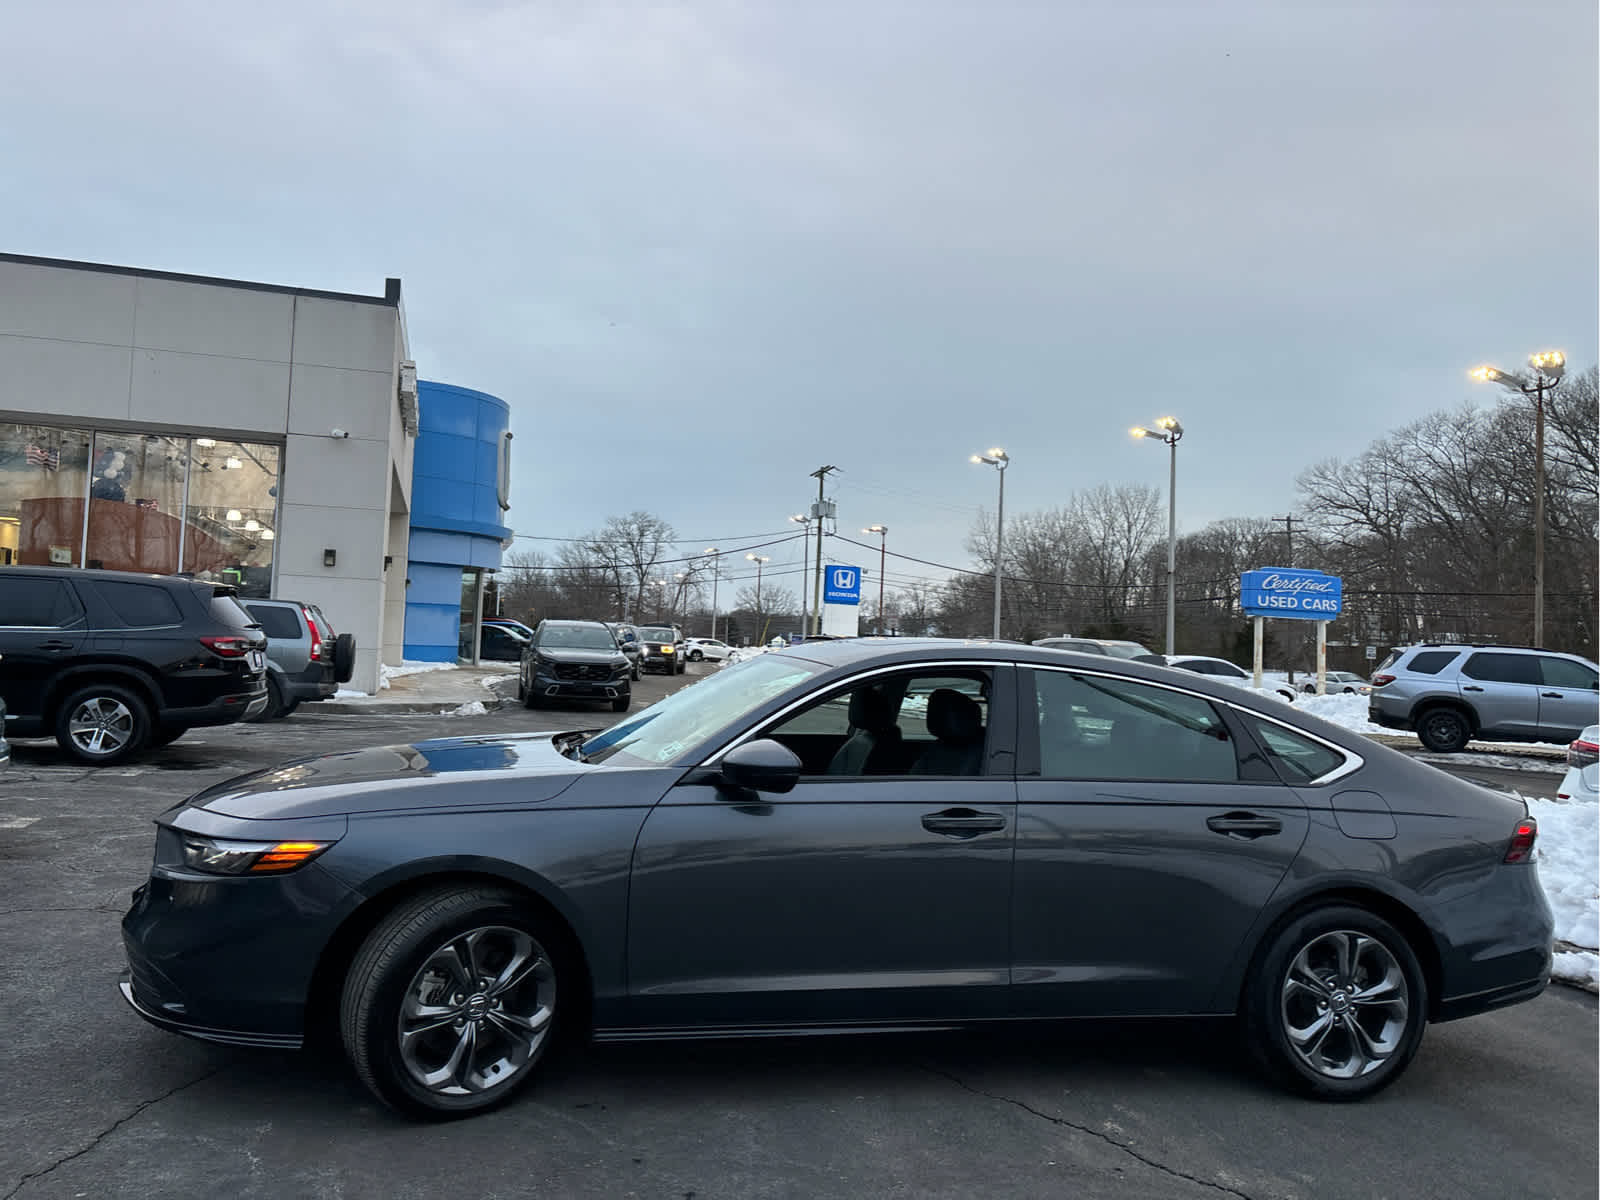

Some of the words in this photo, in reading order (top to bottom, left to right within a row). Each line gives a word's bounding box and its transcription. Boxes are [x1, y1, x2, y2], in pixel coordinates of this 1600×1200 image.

[1262, 574, 1334, 595] Certified
[1257, 595, 1298, 608] USED
[1302, 598, 1338, 611] CARS
